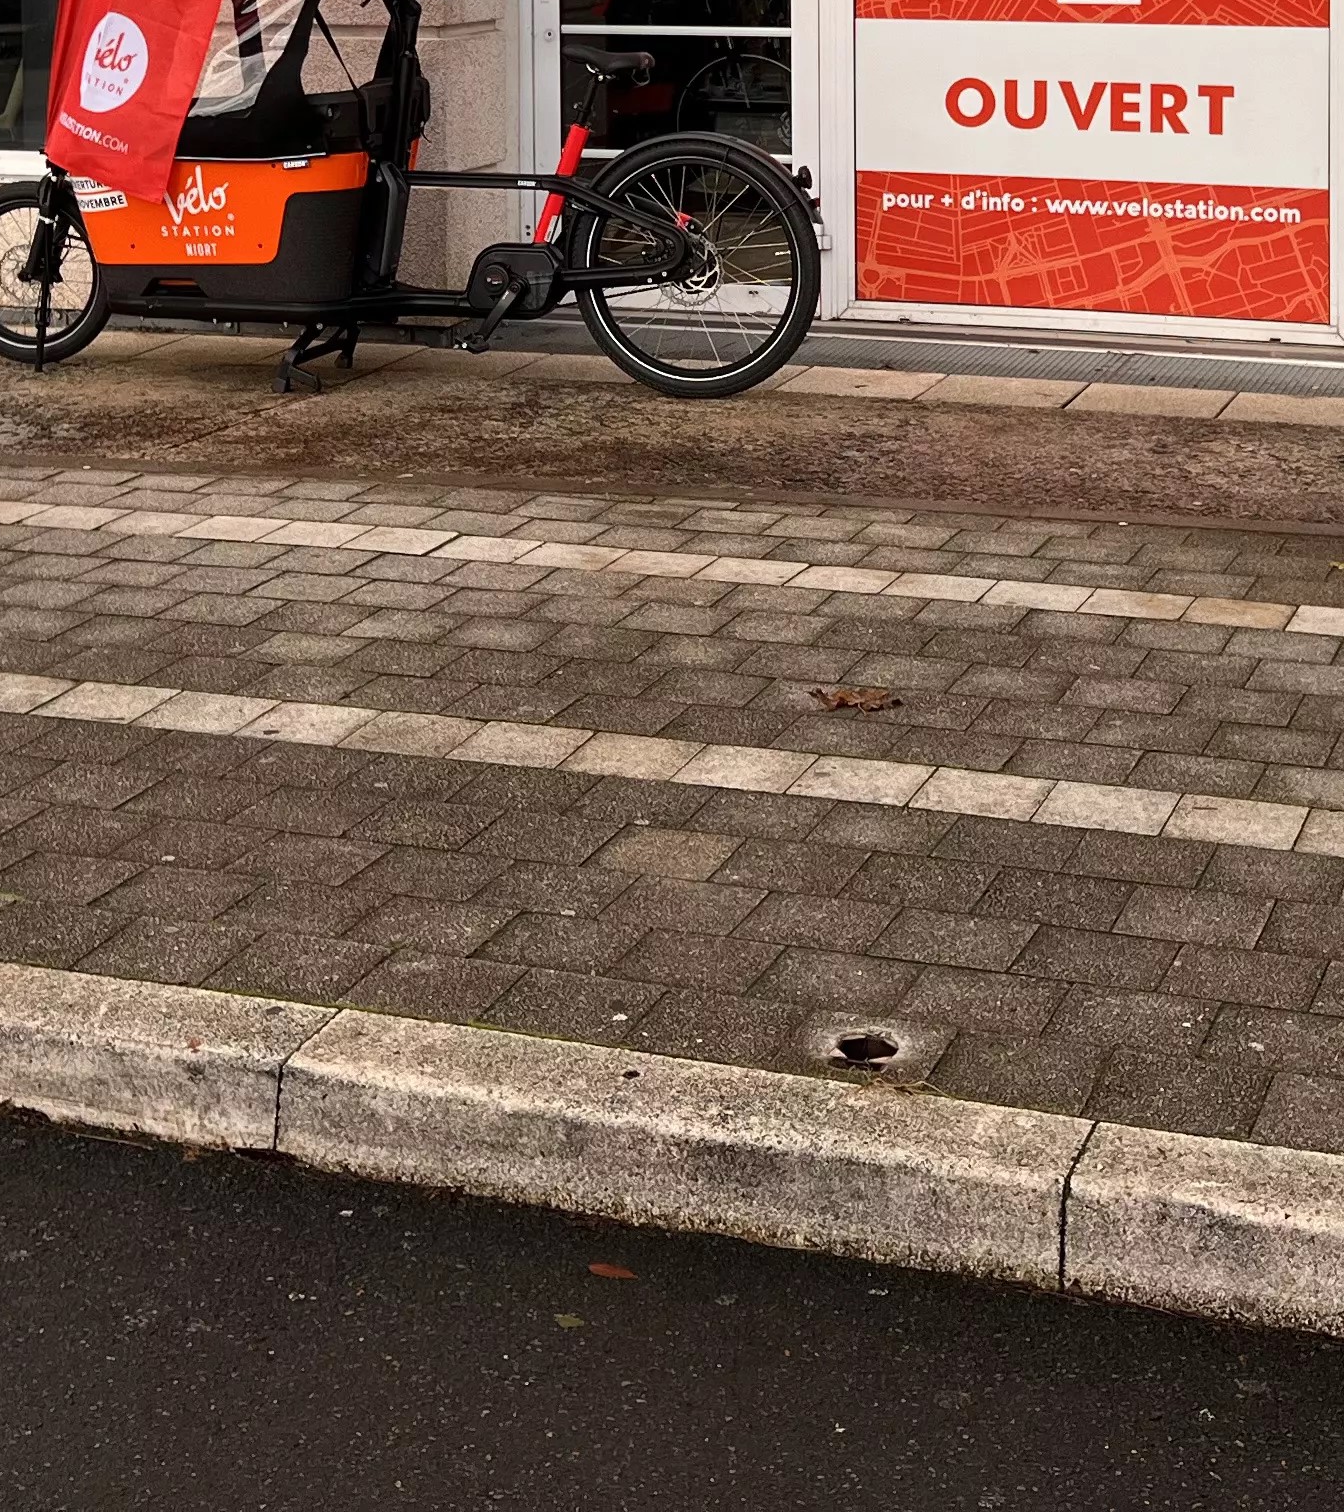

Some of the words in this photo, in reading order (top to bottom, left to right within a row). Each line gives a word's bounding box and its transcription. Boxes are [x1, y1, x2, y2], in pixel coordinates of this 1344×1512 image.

[945, 77, 1235, 136] OUVERT
[76, 195, 125, 209] OVEMBRE
[163, 164, 229, 225] Vélo
[883, 191, 934, 211] pour
[941, 195, 953, 207] +
[1046, 196, 1302, 224] www.velostation.com
[161, 224, 235, 238] STATION
[185, 243, 217, 257] NIORT
